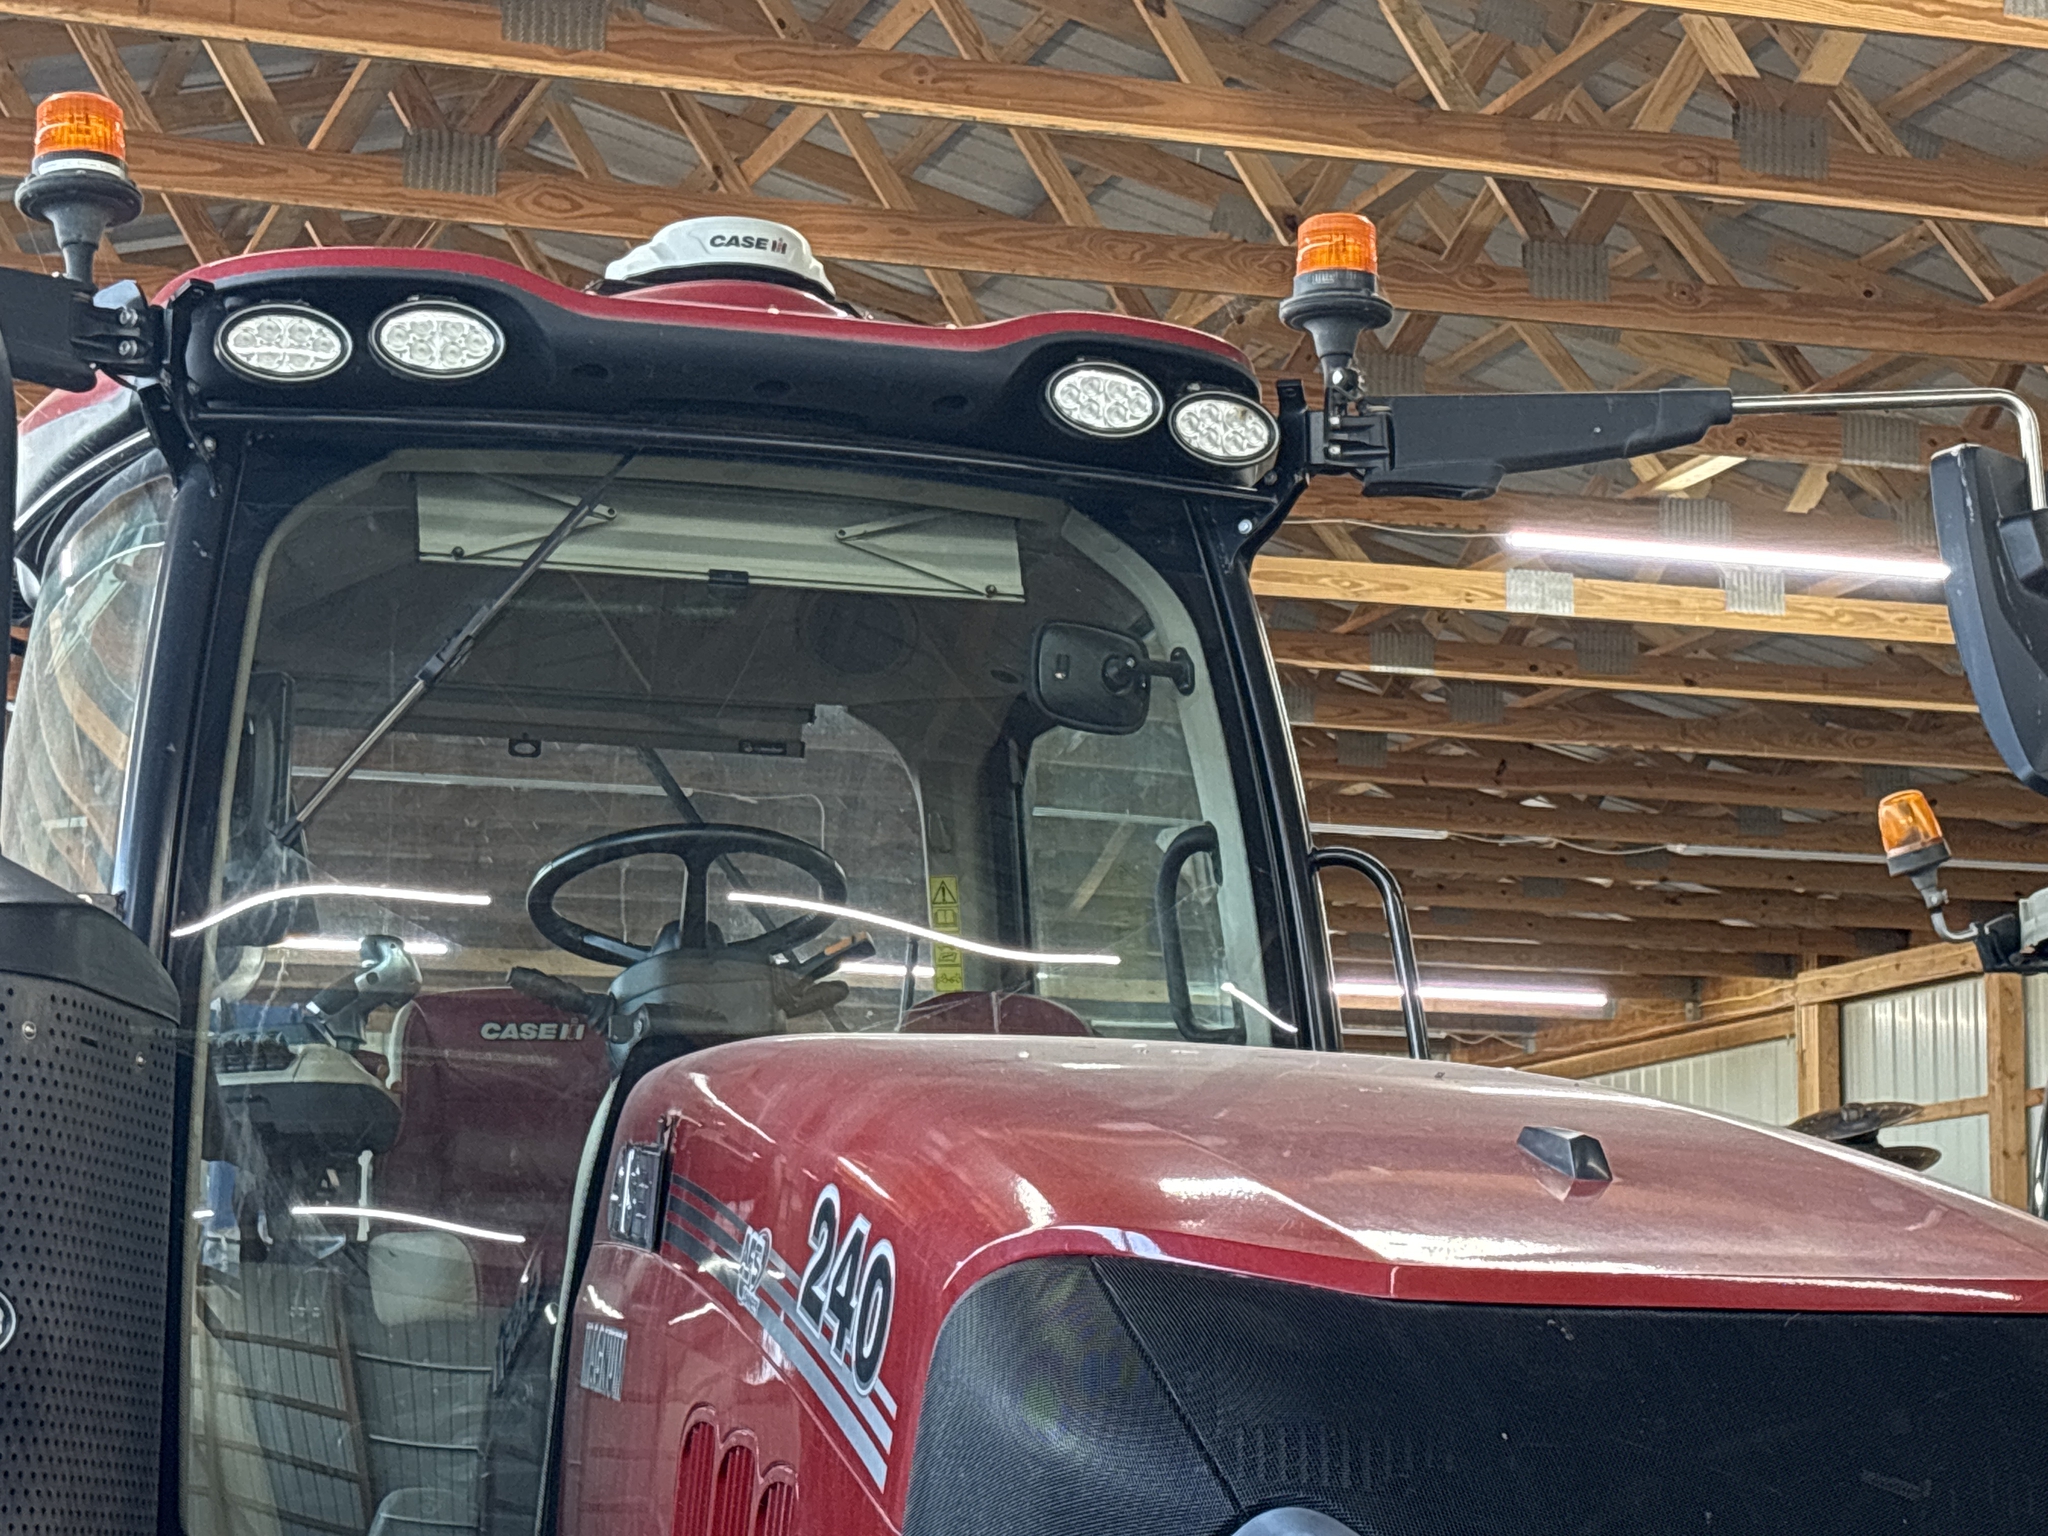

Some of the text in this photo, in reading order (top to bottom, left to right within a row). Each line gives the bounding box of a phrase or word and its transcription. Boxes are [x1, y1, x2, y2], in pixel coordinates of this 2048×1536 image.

[709, 235, 769, 250] CASE
[480, 1022, 558, 1040] CASE
[796, 1183, 896, 1396] 240
